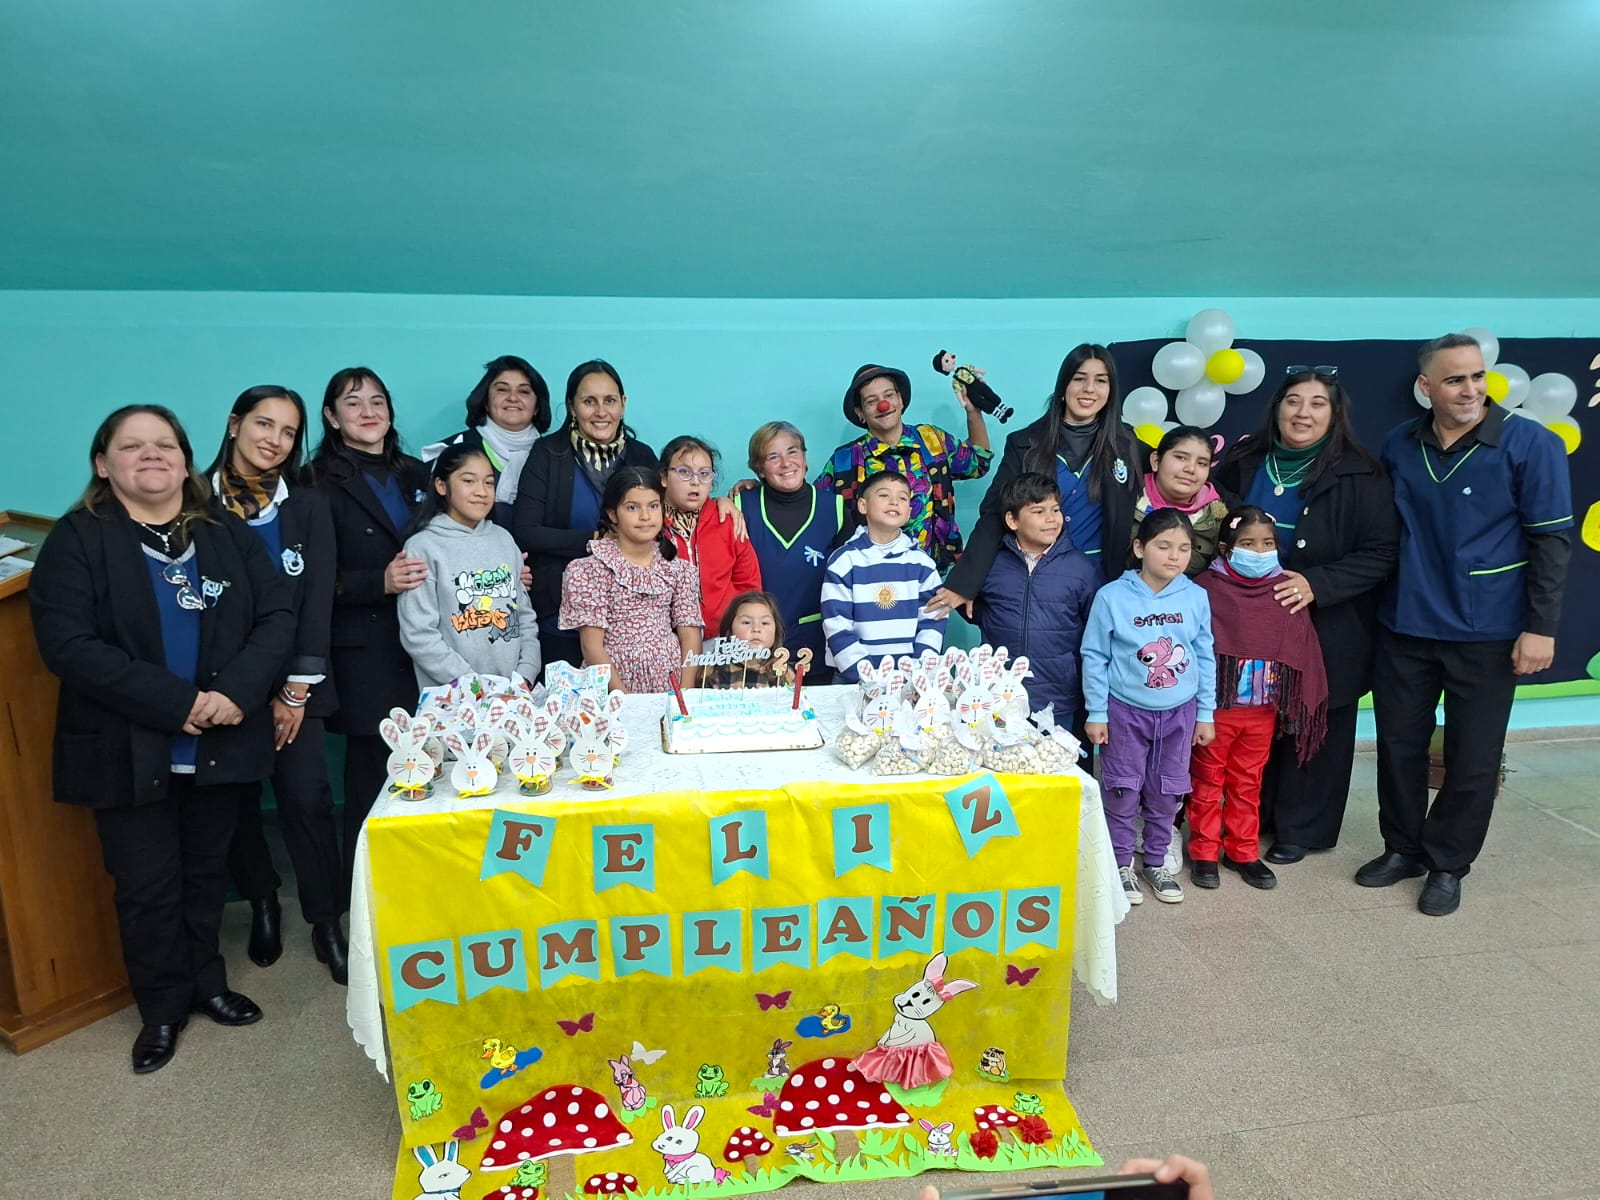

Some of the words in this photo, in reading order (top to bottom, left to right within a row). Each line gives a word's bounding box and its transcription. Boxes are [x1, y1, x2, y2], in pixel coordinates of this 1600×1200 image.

[1134, 612, 1183, 627] STITCH
[495, 785, 1002, 875] FELIZ
[401, 893, 1051, 990] CUMPLEAÑOS
